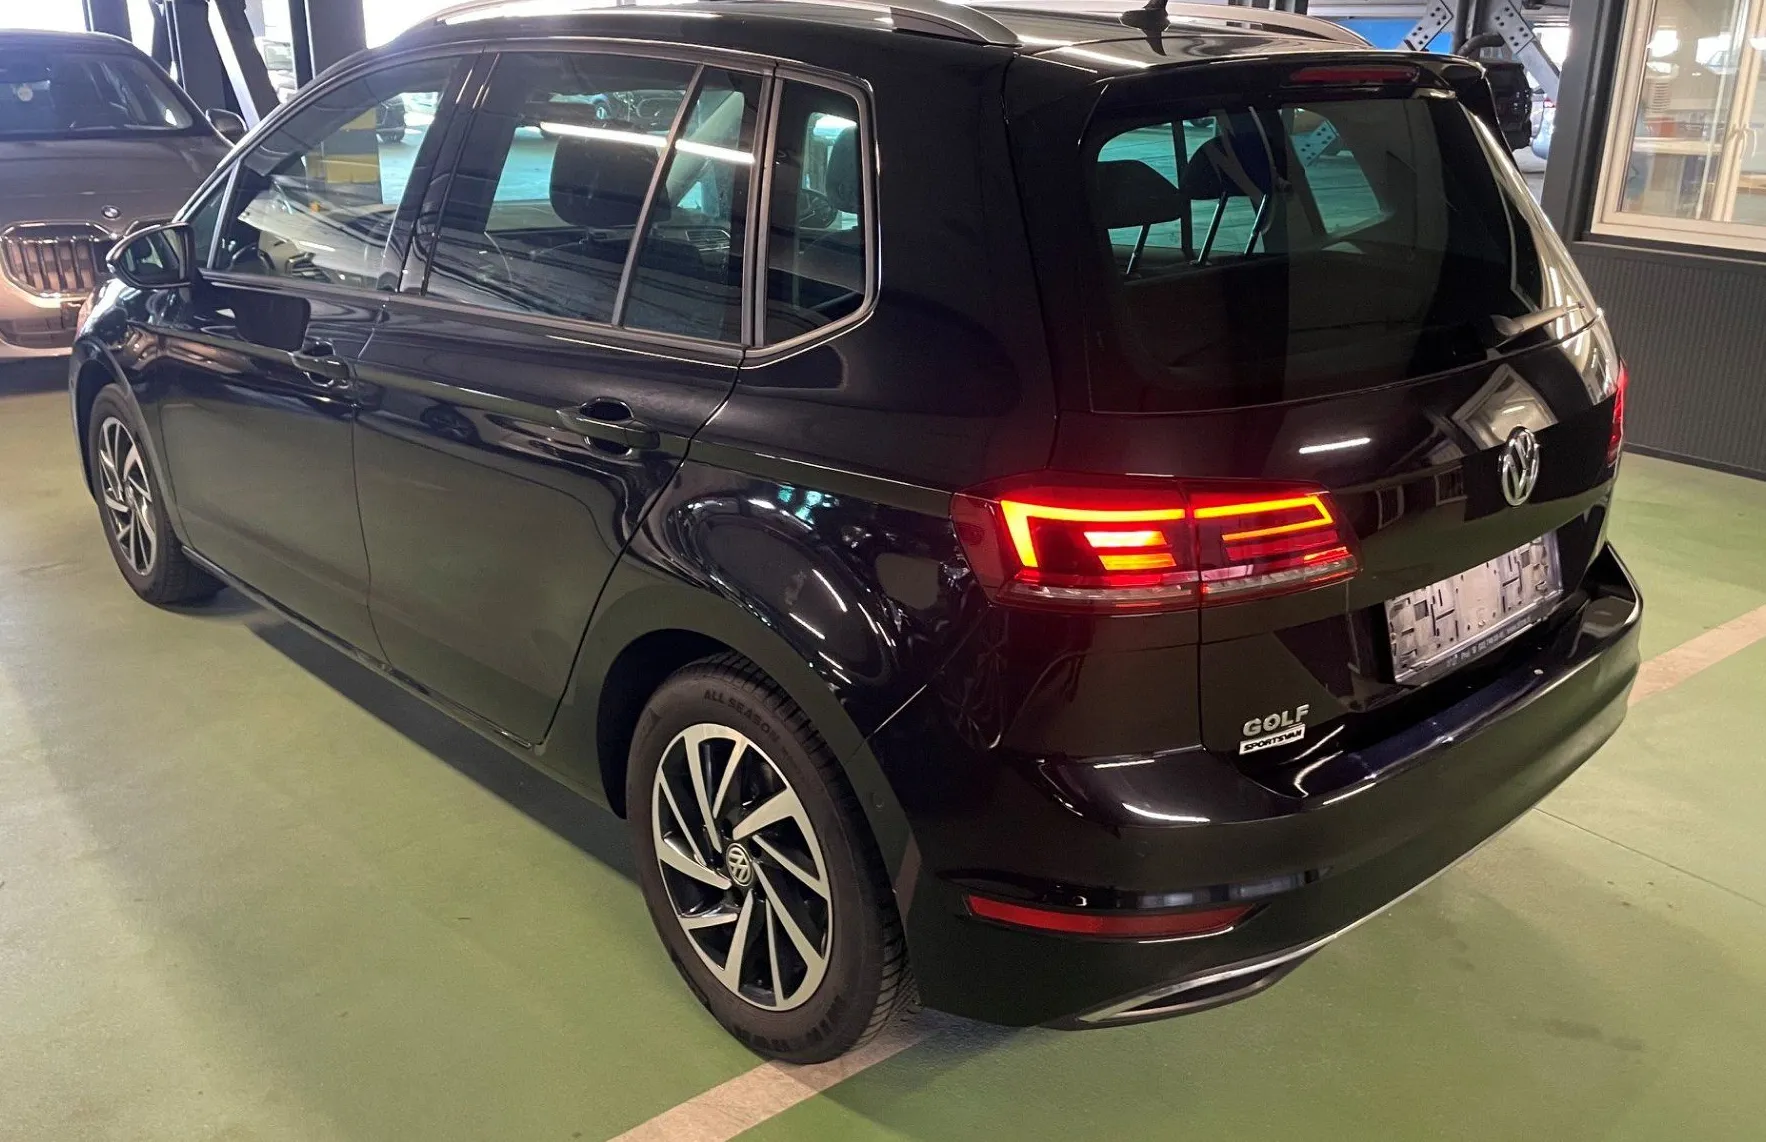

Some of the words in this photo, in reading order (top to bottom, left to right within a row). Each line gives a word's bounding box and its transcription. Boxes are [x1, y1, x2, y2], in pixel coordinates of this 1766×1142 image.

[704, 689, 725, 704] ALL
[728, 698, 780, 743] SEASON
[1243, 704, 1310, 737] GOLF
